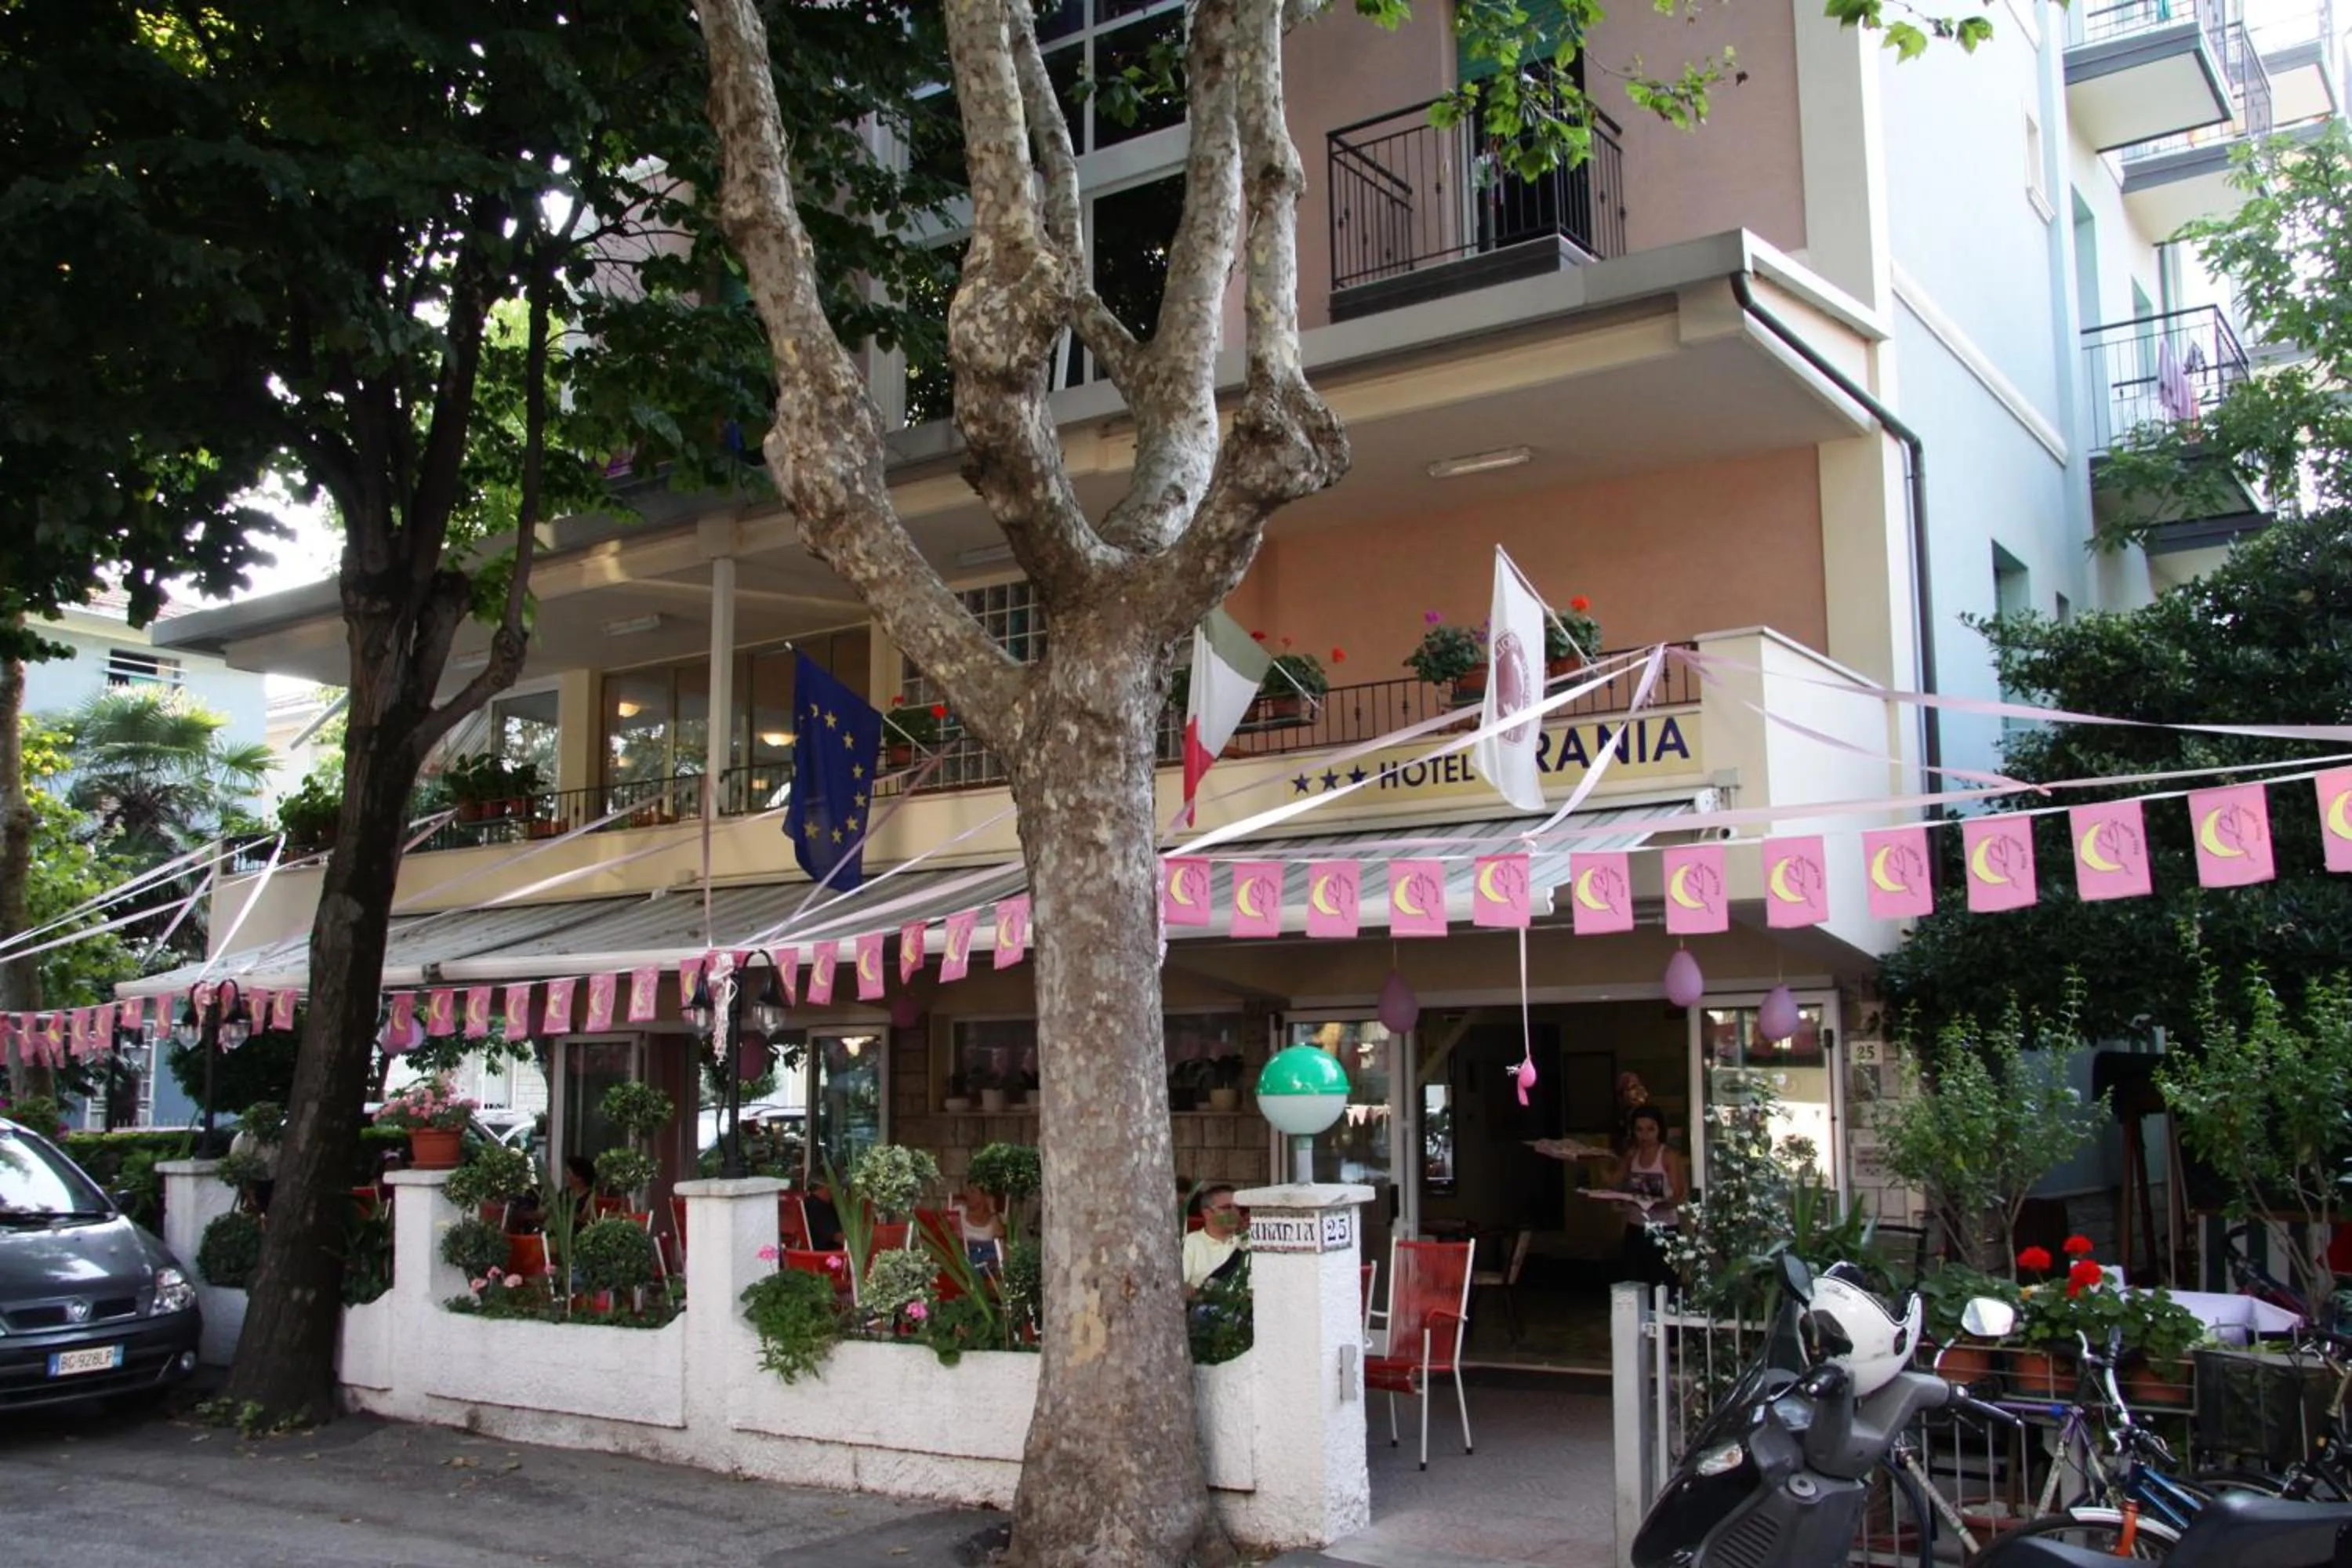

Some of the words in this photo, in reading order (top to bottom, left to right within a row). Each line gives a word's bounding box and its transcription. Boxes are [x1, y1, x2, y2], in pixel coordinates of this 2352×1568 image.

[1379, 753, 1475, 790] HOTEL
[1534, 715, 1691, 774] RANIA
[1857, 1045, 1875, 1059] 25
[1326, 1218, 1347, 1241] 25
